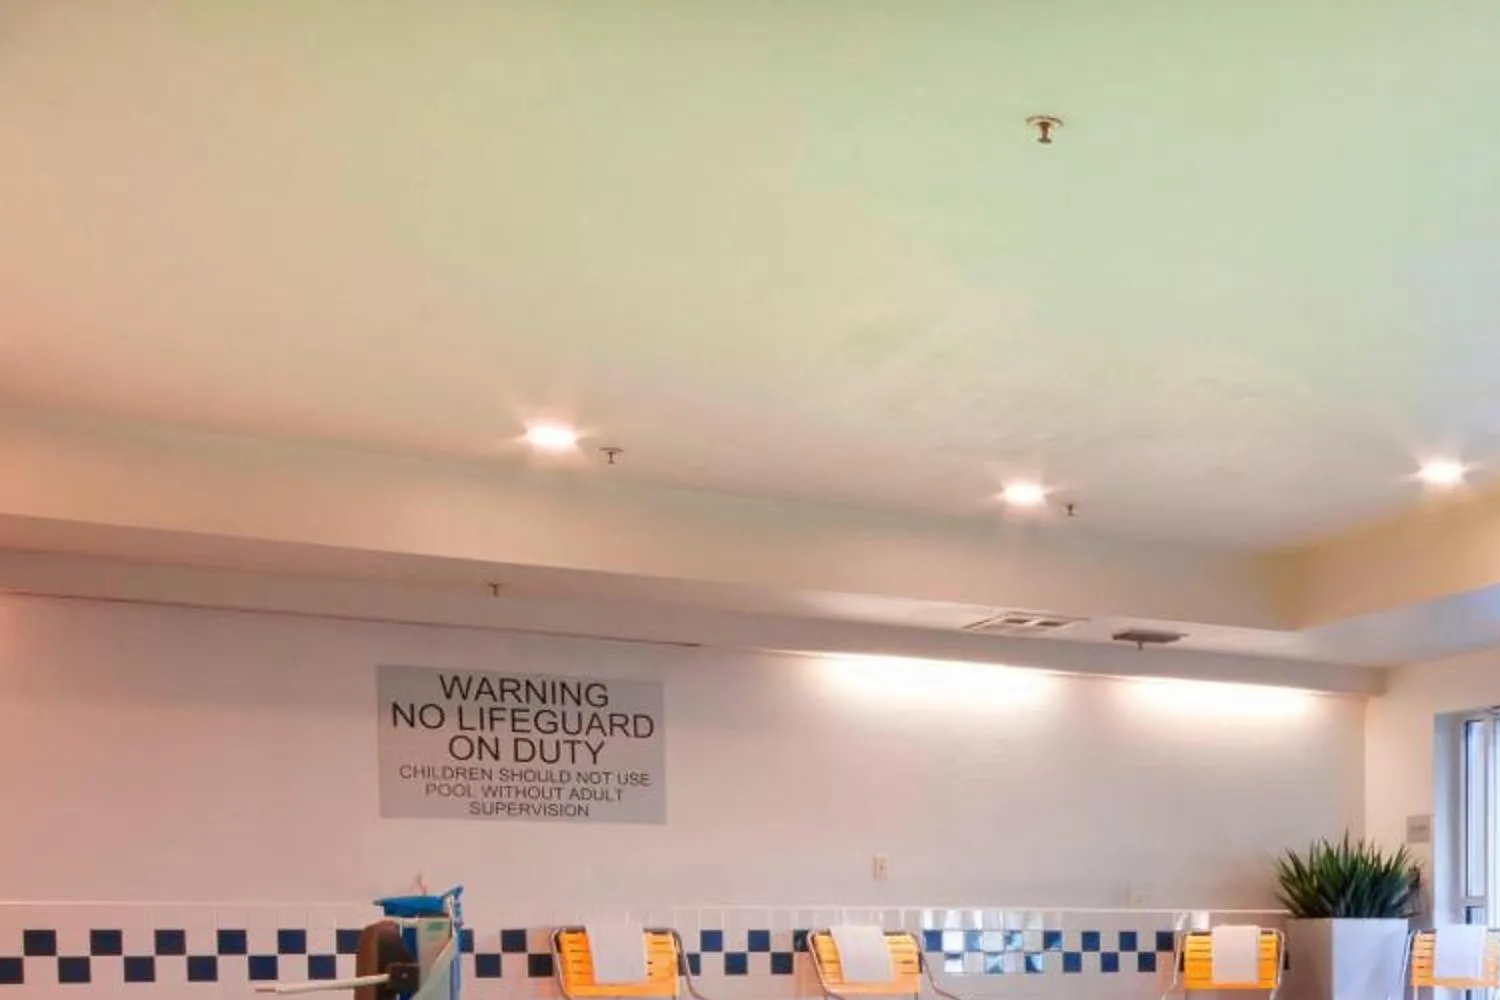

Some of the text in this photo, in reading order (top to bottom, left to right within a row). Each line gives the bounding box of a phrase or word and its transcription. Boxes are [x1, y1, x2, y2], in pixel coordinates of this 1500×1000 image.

[439, 674, 609, 708] WARNING
[391, 702, 655, 739] NO LIFEGUARD
[449, 735, 605, 764] ON DUTY
[400, 764, 651, 786] CHILDREN SHOULD NOT USE
[425, 784, 625, 802] POOL WITHOUT ADULT
[469, 801, 590, 818] SUPERVISION
